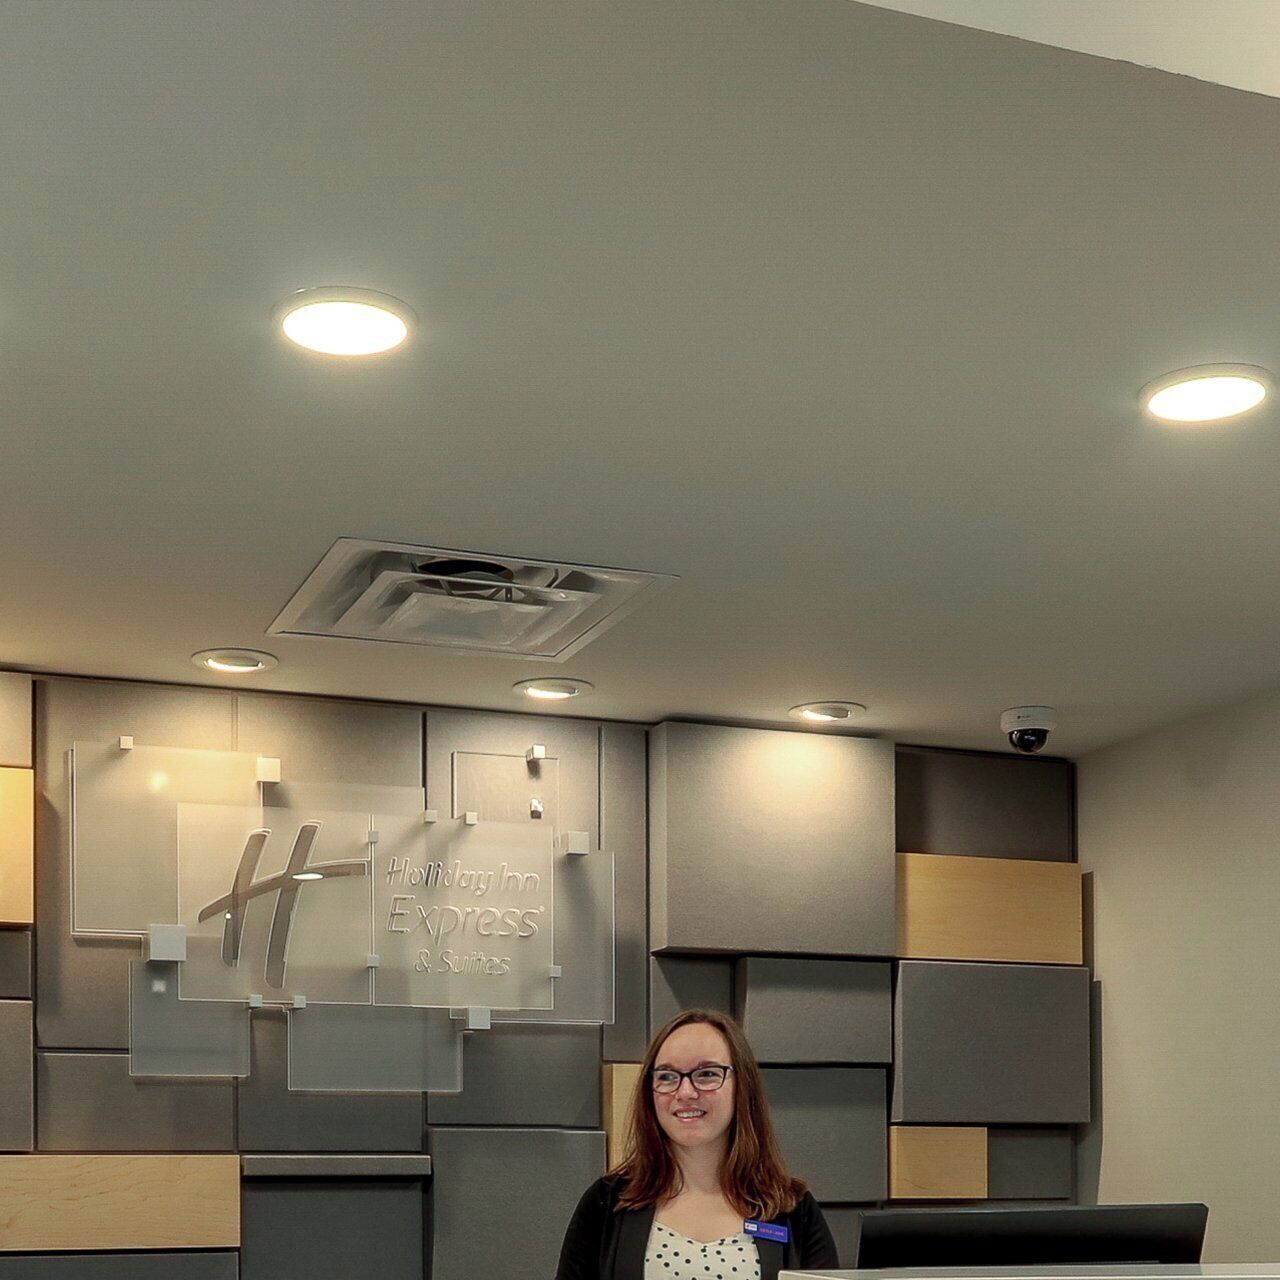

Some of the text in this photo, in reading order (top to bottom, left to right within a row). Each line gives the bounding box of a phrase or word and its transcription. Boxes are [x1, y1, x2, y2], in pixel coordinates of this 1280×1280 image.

[387, 857, 541, 896] Holiday Inn
[415, 949, 511, 976] & Suites
